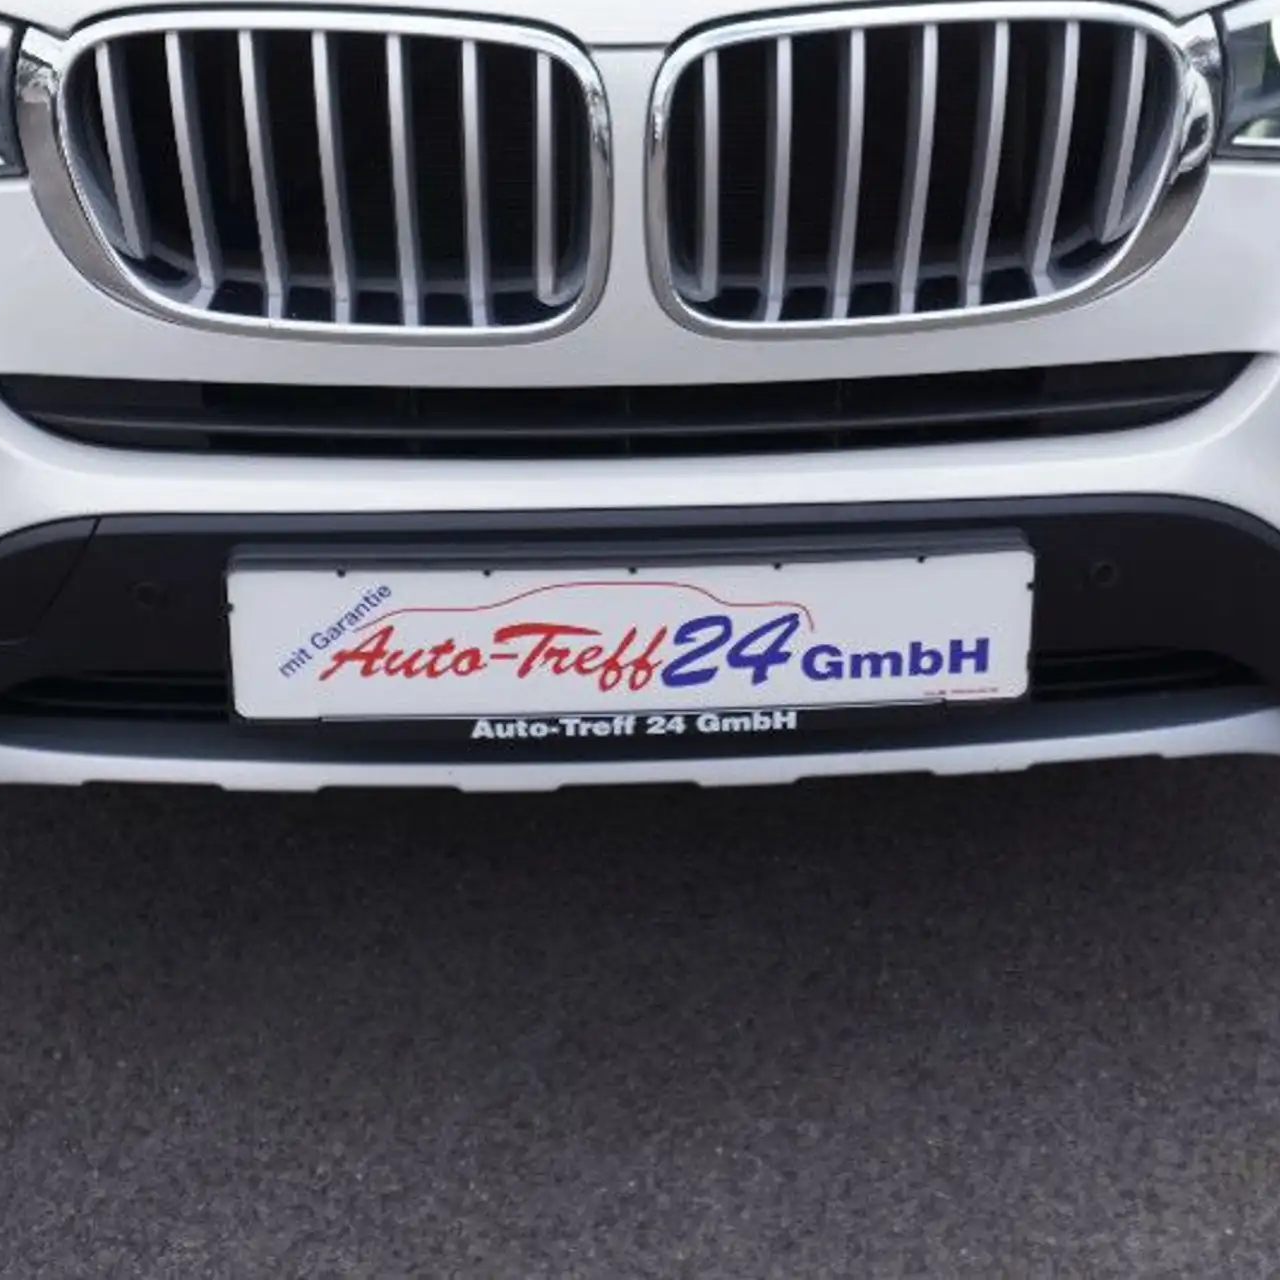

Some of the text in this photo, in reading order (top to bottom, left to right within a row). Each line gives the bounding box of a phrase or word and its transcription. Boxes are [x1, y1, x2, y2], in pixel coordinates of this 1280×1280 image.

[278, 583, 393, 679] mit Garantie
[800, 637, 990, 681] GmbH
[471, 710, 798, 740] Auto-Treff 24 GmbH
